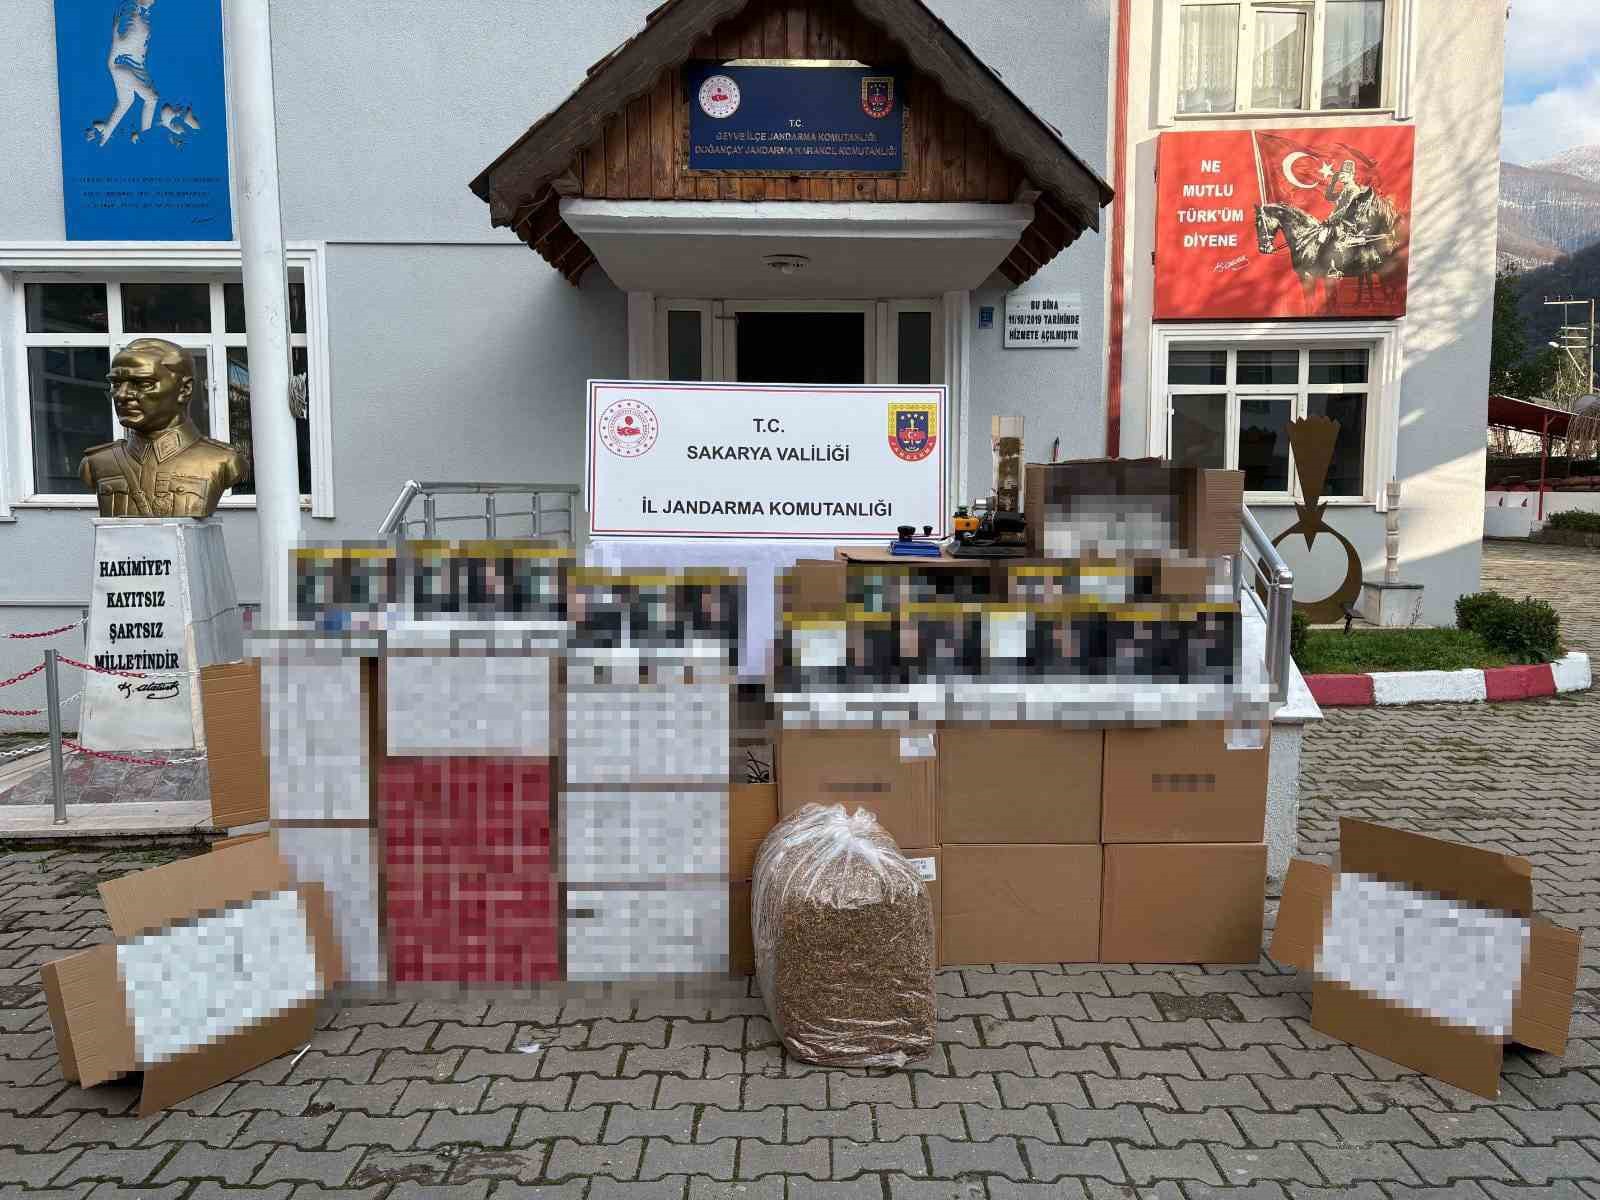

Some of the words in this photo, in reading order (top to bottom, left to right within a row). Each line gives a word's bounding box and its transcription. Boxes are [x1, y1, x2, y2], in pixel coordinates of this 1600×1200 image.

[788, 119, 804, 128] T.C.
[1200, 159, 1221, 173] NE
[1183, 184, 1233, 197] MUTLU
[1177, 208, 1244, 223] TÜRK'ÜM
[1183, 232, 1237, 248] DİYENE
[1030, 300, 1041, 310] BU
[1042, 299, 1059, 310] BİNA
[1044, 313, 1080, 325] TARİHİNDE
[1009, 328, 1039, 340] HİZMETE
[1041, 329, 1079, 342] AÇILMIŞTIR
[753, 418, 785, 433] T.C.
[687, 445, 772, 461] SAKARYA
[777, 444, 850, 462] VALİLİĞİ
[641, 496, 661, 515] İL
[662, 500, 764, 516] JANDARMA
[769, 500, 892, 517] KOMUTANLIĞI
[99, 556, 172, 577] HAKİMİYET
[107, 591, 166, 608] KAYITSIZ
[109, 622, 164, 644] ŞARTSIZ
[95, 649, 180, 671] MİLLETİNDİR
